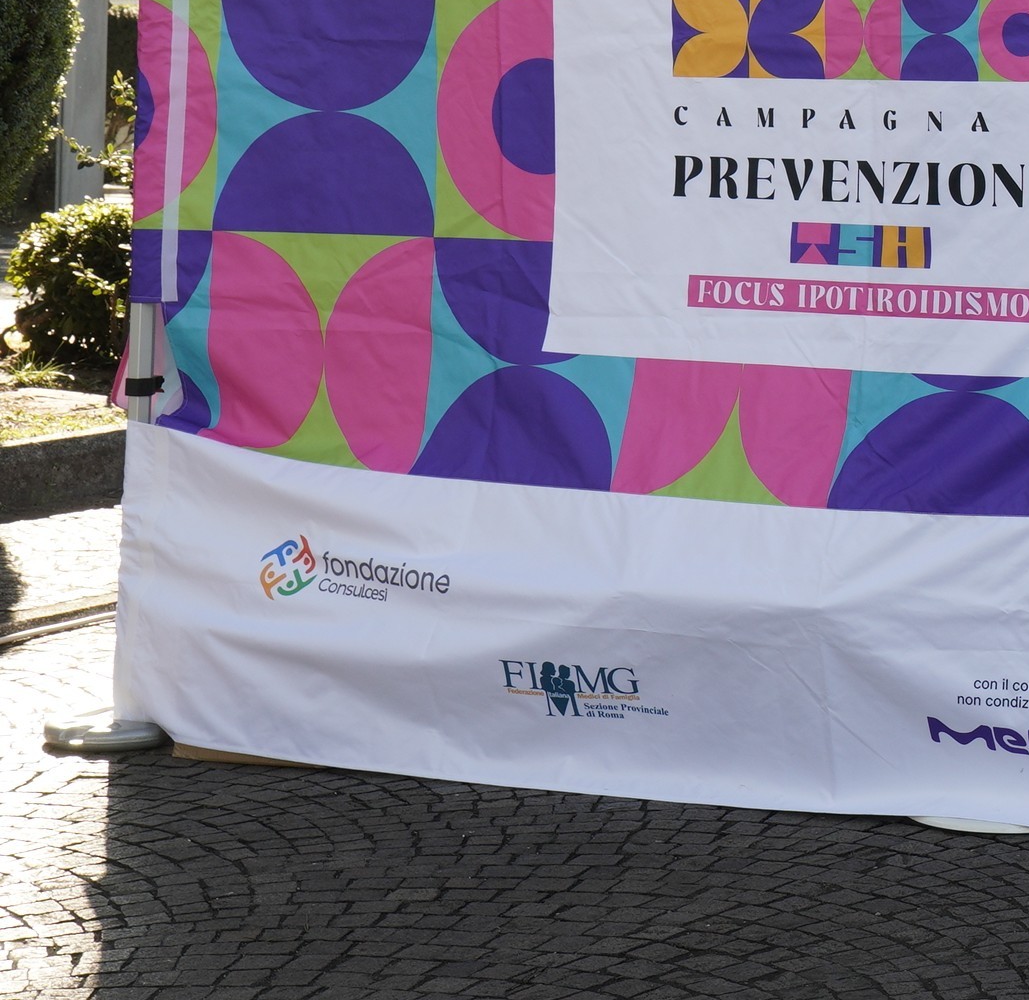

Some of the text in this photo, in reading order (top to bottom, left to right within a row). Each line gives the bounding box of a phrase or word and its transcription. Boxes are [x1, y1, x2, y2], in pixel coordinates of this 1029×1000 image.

[673, 105, 990, 133] CAMPAGNA
[697, 279, 1029, 319] FOCUS IPOTIROIDISMO
[322, 551, 450, 594] fondazione
[318, 578, 388, 602] Consulcesi
[507, 687, 545, 697] Federazione
[973, 679, 998, 691] con
[1002, 678, 1009, 691] il
[957, 695, 981, 706] non
[584, 702, 669, 717] Sezione Provinciale
[586, 710, 625, 719] di Roma
